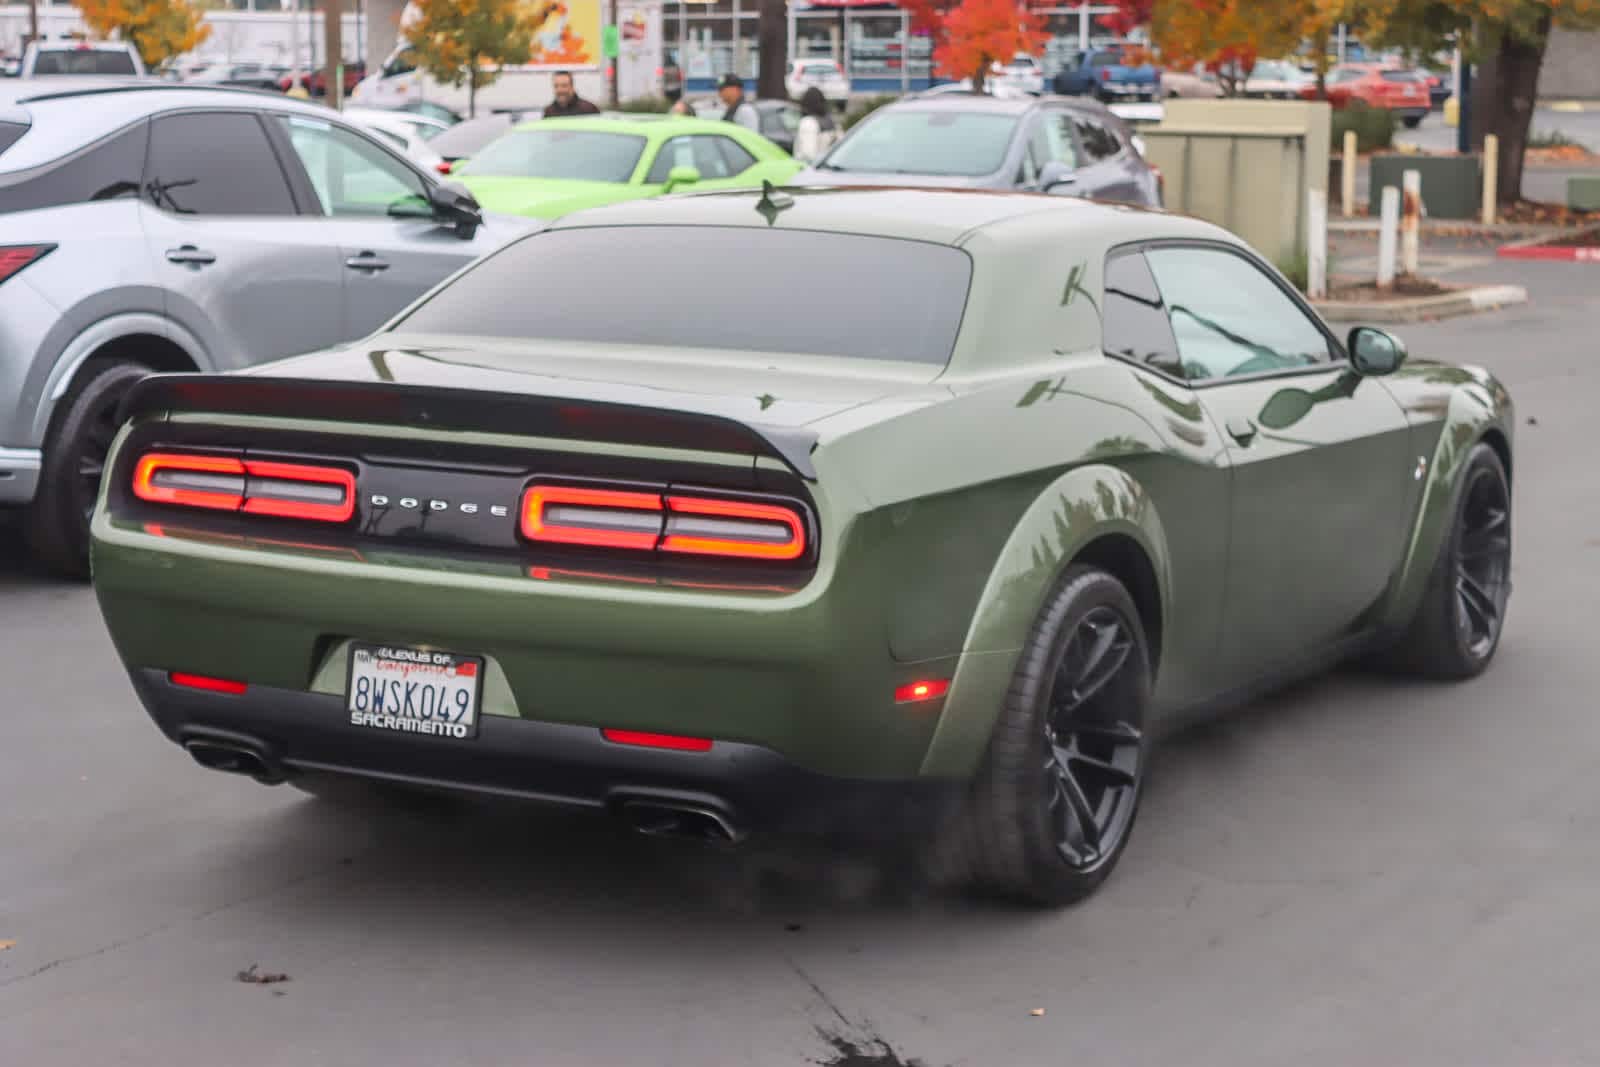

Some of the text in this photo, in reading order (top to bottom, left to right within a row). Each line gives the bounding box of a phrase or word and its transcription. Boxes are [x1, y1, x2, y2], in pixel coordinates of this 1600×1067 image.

[371, 494, 507, 516] DODGE
[388, 648, 452, 665] LEXUS OF
[355, 676, 469, 724] 8WSK049
[351, 711, 467, 738] SACRAMENTO
